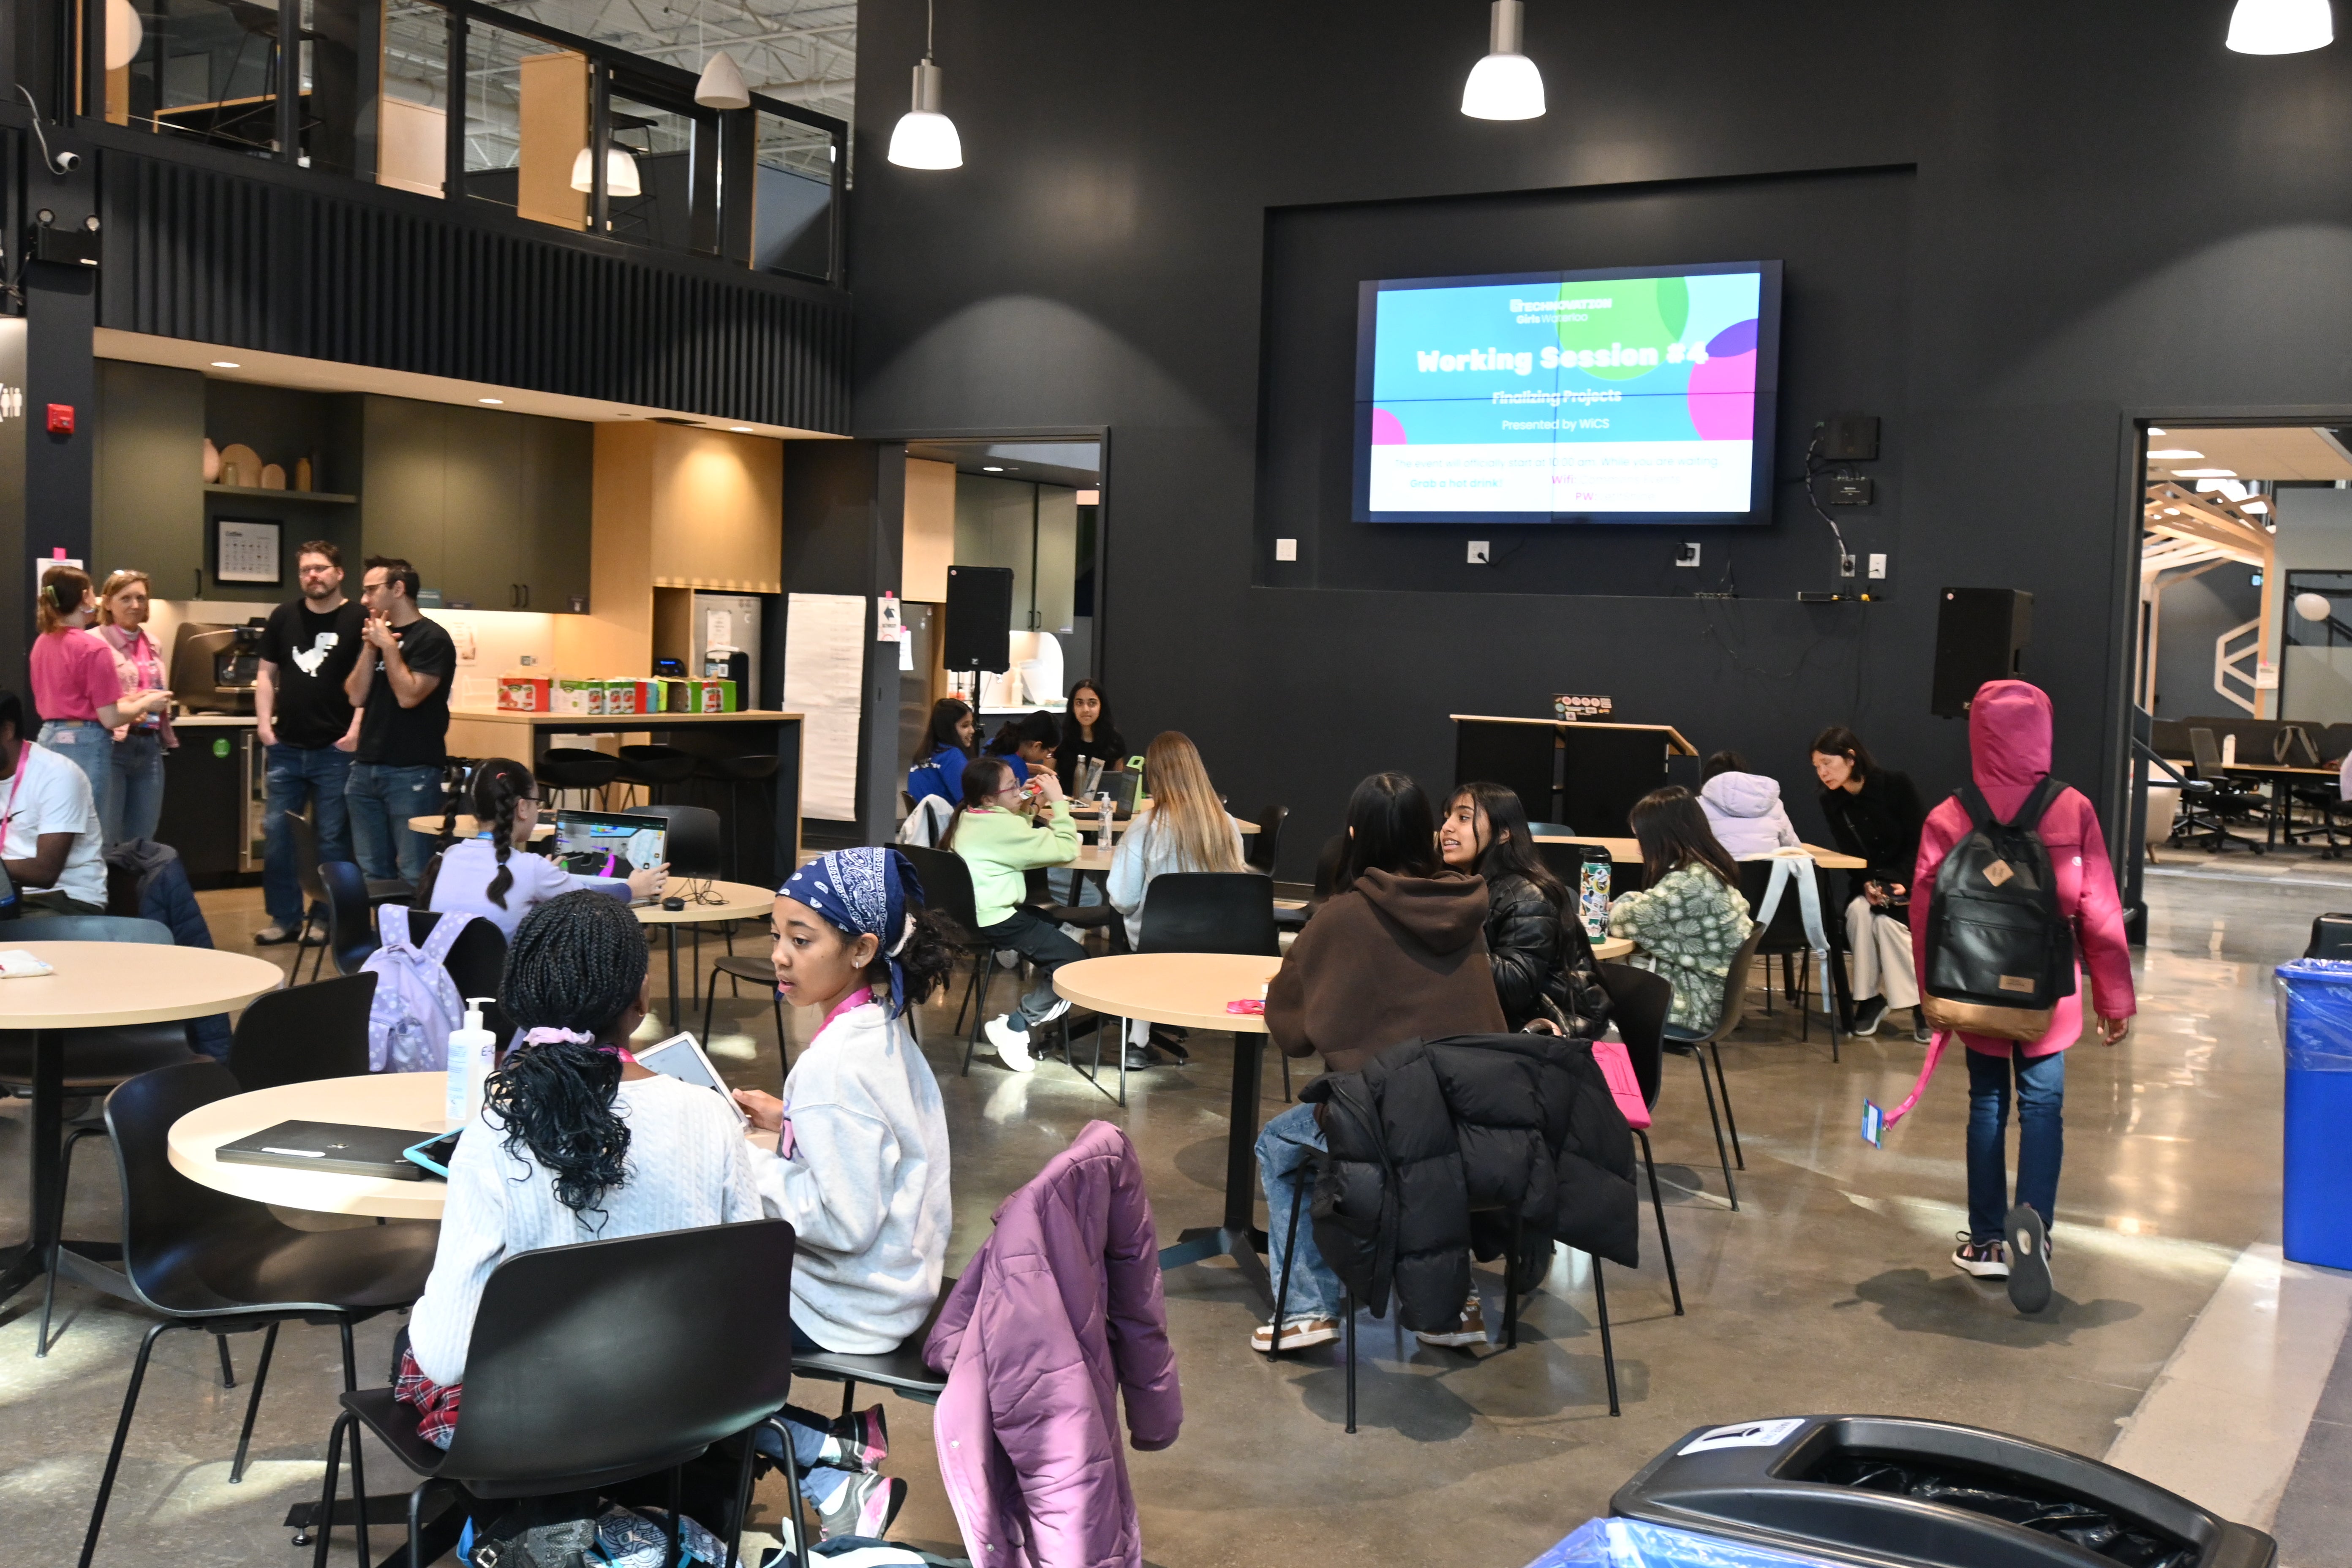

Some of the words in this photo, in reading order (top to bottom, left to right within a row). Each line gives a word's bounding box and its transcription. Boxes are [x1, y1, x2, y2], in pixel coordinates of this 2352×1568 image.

[1516, 314, 1541, 324] Girls
[1542, 313, 1588, 323] Waterloo
[1417, 347, 1533, 376] Working
[1540, 342, 1658, 369] Session
[1666, 341, 1709, 364] #4
[1492, 390, 1560, 407] Finalizing
[1563, 388, 1622, 406] Projects
[1502, 419, 1559, 430] Presented
[1562, 419, 1577, 432] by
[1579, 418, 1610, 429] WiCS
[1395, 459, 1411, 468] The
[1415, 459, 1442, 468] event
[1509, 458, 1531, 467] start
[1535, 458, 1545, 467] at
[1410, 478, 1437, 488] Grab
[1449, 478, 1467, 488] hot
